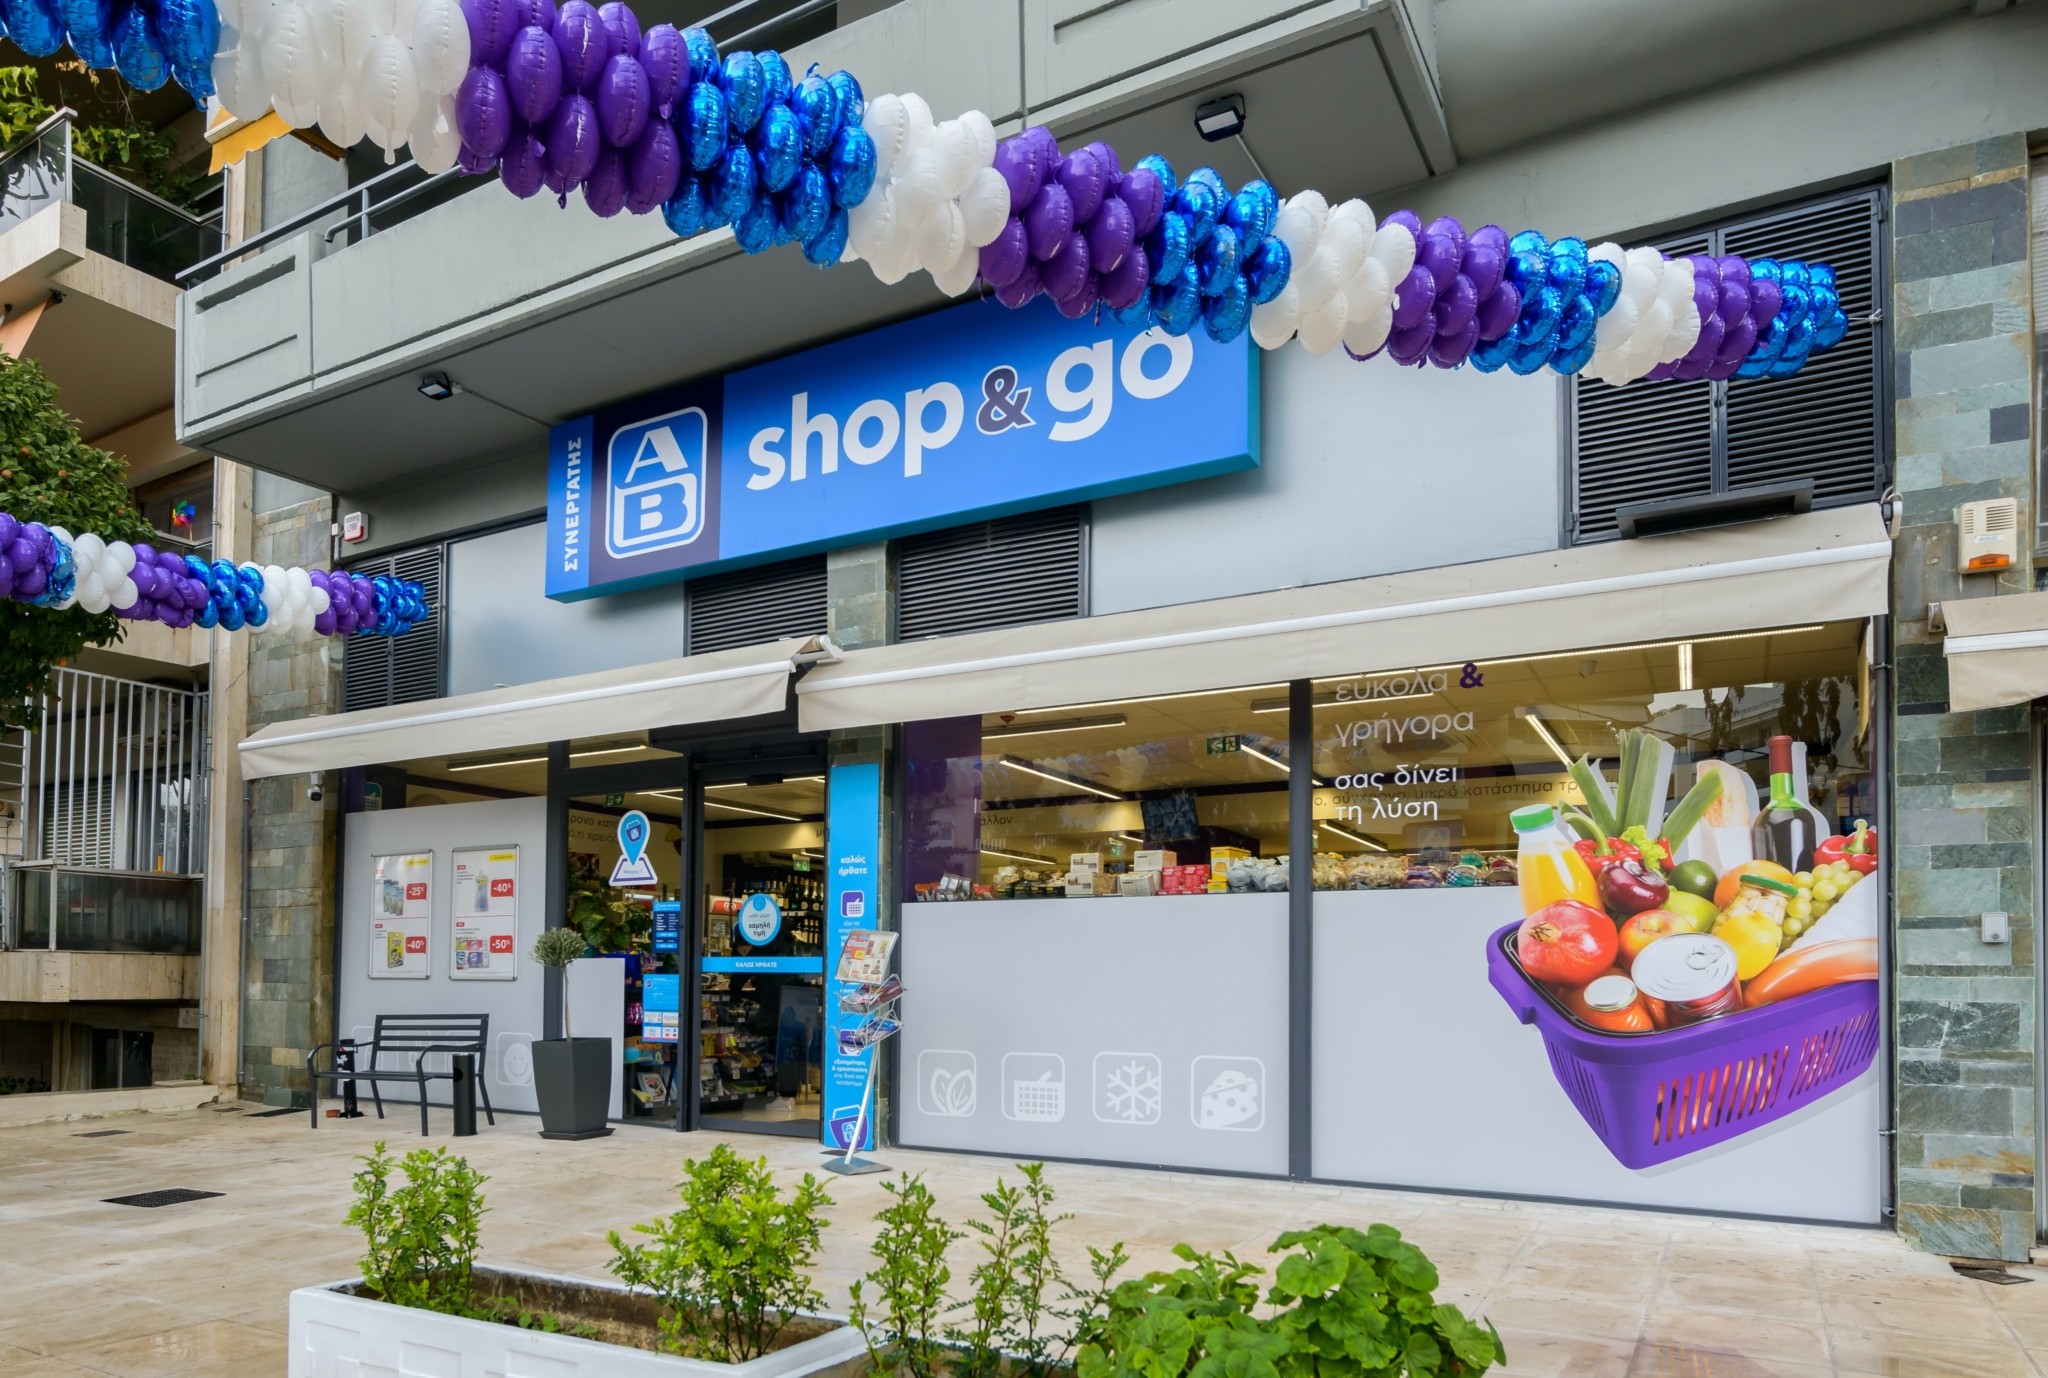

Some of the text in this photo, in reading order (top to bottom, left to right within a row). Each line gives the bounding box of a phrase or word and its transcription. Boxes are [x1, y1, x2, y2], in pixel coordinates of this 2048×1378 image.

[746, 325, 1194, 491] shop & go
[564, 435, 582, 572] ΣΥΝΕΡΓΑΤΗΣ
[1459, 662, 1485, 689] &
[1335, 711, 1474, 748] γρήγορα
[1334, 763, 1457, 791] σας δίνει
[1463, 780, 1553, 798] κατάστημα
[1335, 797, 1438, 825] τη λύση
[838, 866, 868, 877] ήρθατε
[840, 854, 866, 865] καλώς
